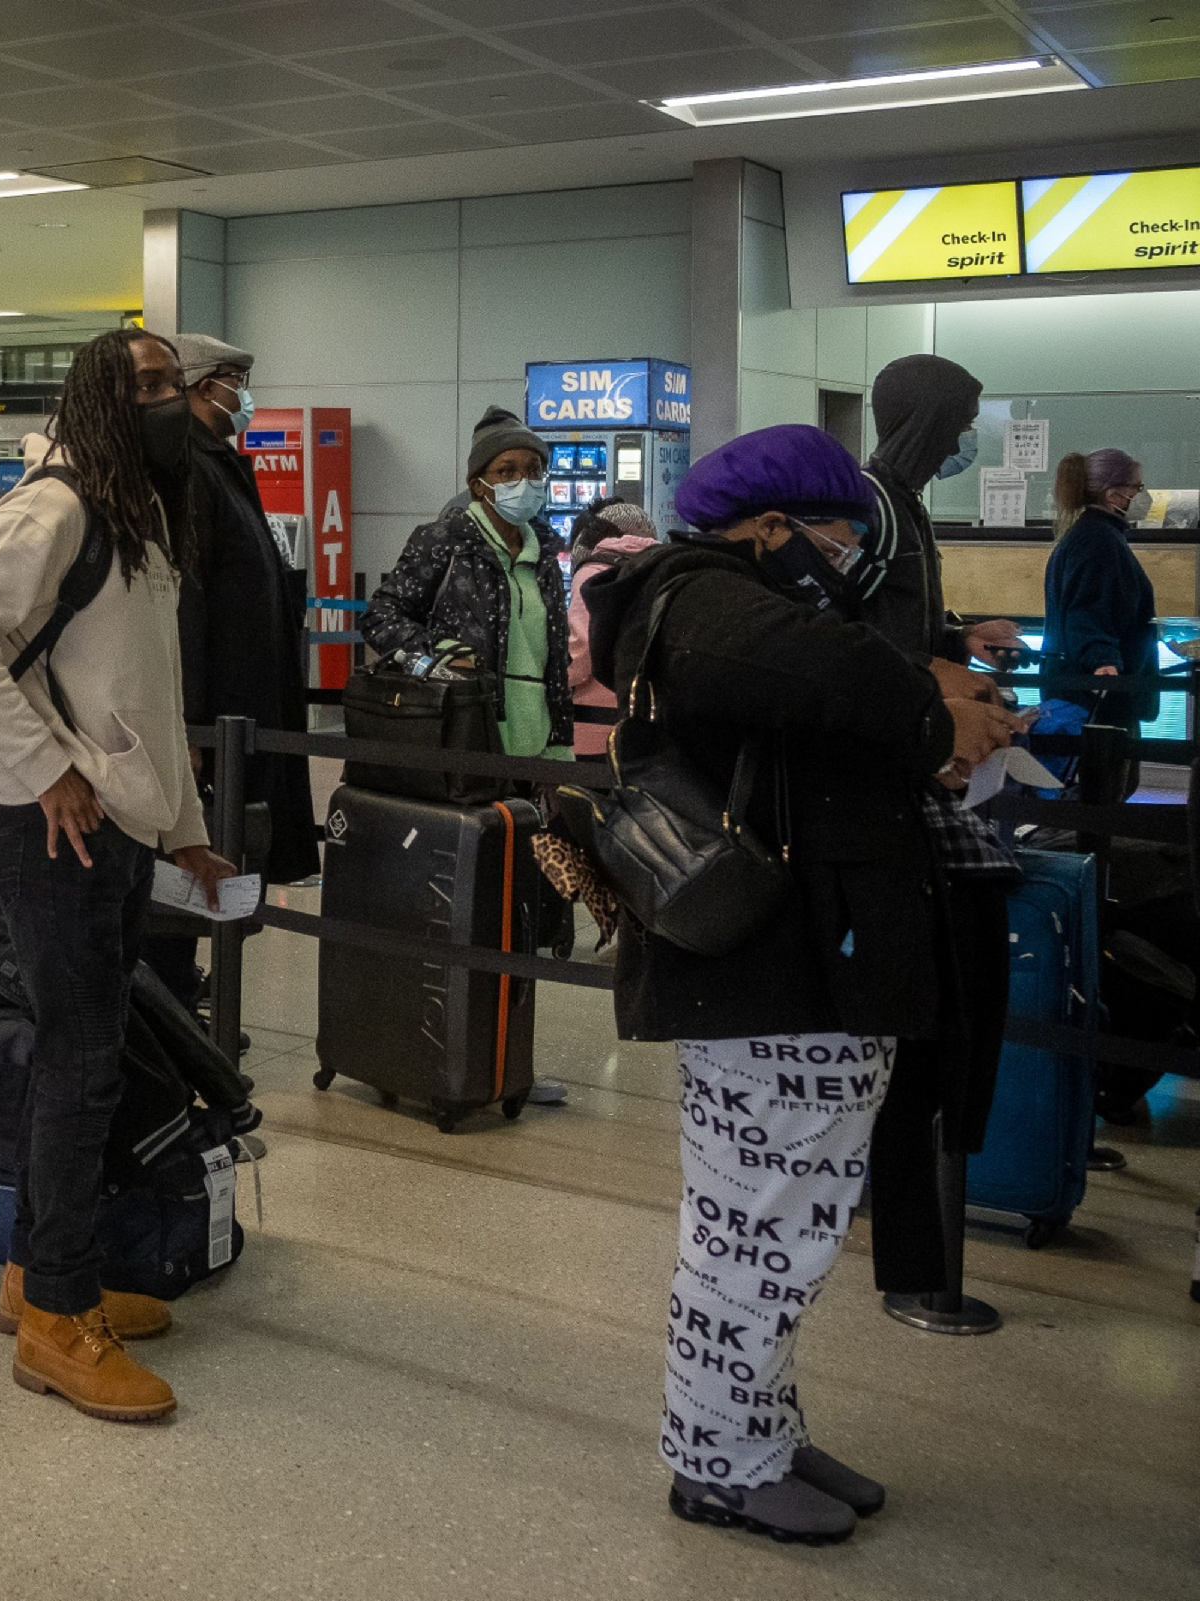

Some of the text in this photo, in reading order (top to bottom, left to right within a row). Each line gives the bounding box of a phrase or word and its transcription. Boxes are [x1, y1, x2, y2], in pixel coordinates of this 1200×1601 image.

[1128, 218, 1200, 235] Check-In
[941, 230, 1007, 246] Check-In
[946, 250, 1006, 270] spirit
[1133, 240, 1200, 260] spirit
[561, 369, 613, 392] SIM
[664, 371, 687, 395] SIM
[539, 398, 634, 420] CARDS
[254, 454, 298, 472] ATM
[777, 1069, 878, 1100] NEW
[768, 1099, 830, 1115] FIFTH
[692, 1224, 792, 1274] SOHO
